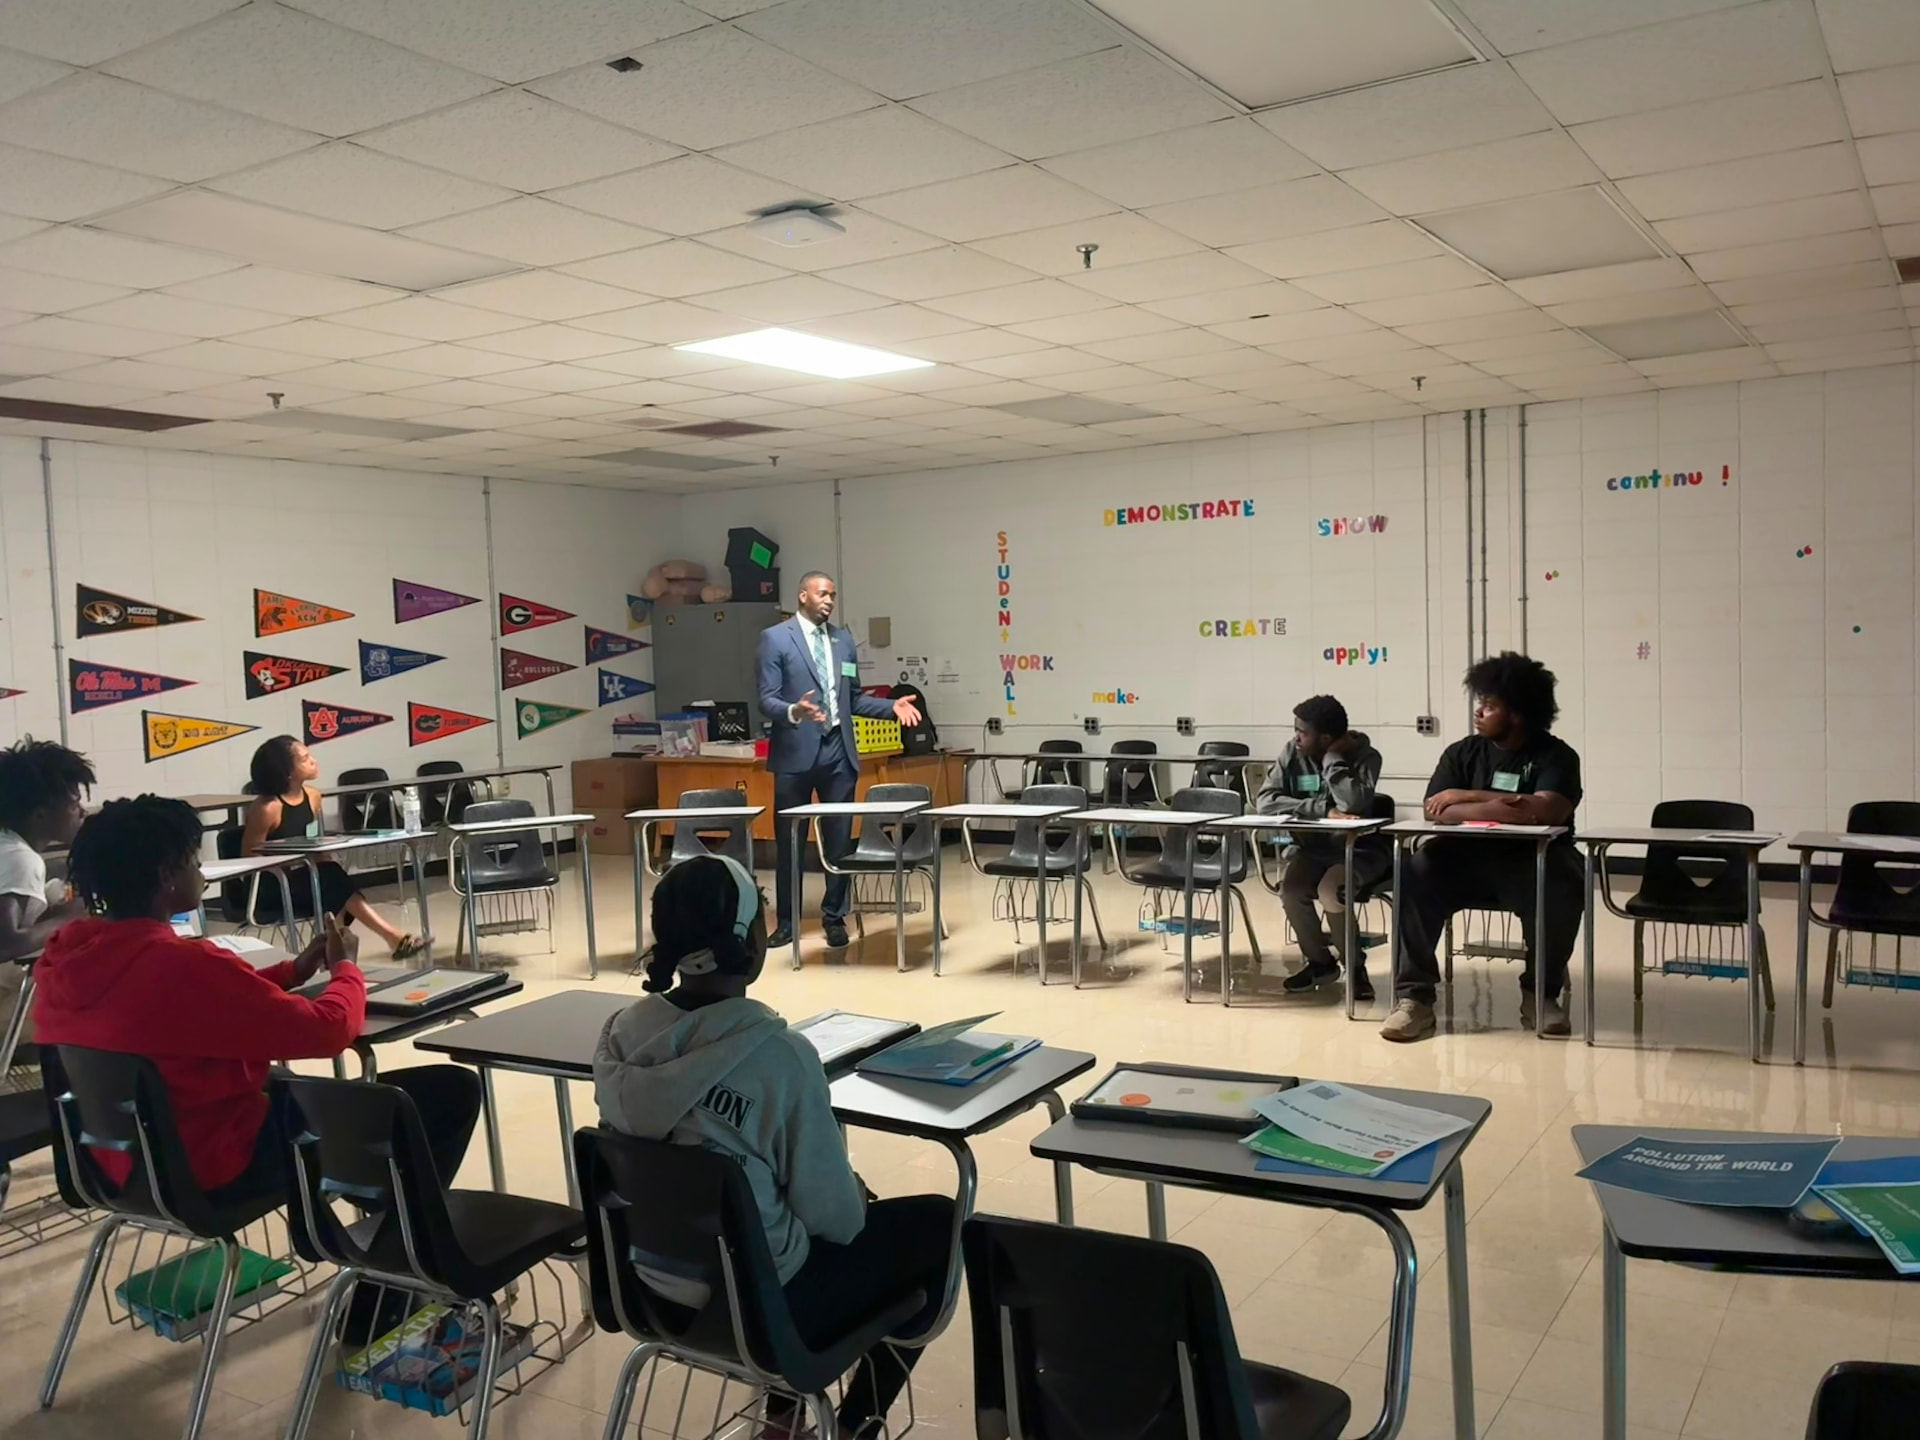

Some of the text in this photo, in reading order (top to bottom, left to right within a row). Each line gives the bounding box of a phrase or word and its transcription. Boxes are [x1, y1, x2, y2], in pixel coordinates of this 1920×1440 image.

[1104, 499, 1255, 526] DEMONSTRATE
[1318, 515, 1388, 536] SHOW
[127, 606, 158, 616] MIZZOU
[505, 605, 532, 625] G
[1199, 618, 1286, 637] CREATE
[1000, 655, 1054, 671] WORK
[1323, 642, 1388, 665] apply!
[273, 668, 330, 690] STATE
[524, 665, 561, 674] BULLDOGS
[76, 672, 100, 691] Ole
[101, 671, 136, 691] Miss
[341, 714, 374, 724] AUBURN
[698, 1085, 751, 1129] ION
[1622, 1153, 1794, 1172] AROUND THE WORLD
[1631, 1146, 1726, 1162] POLLUTION
